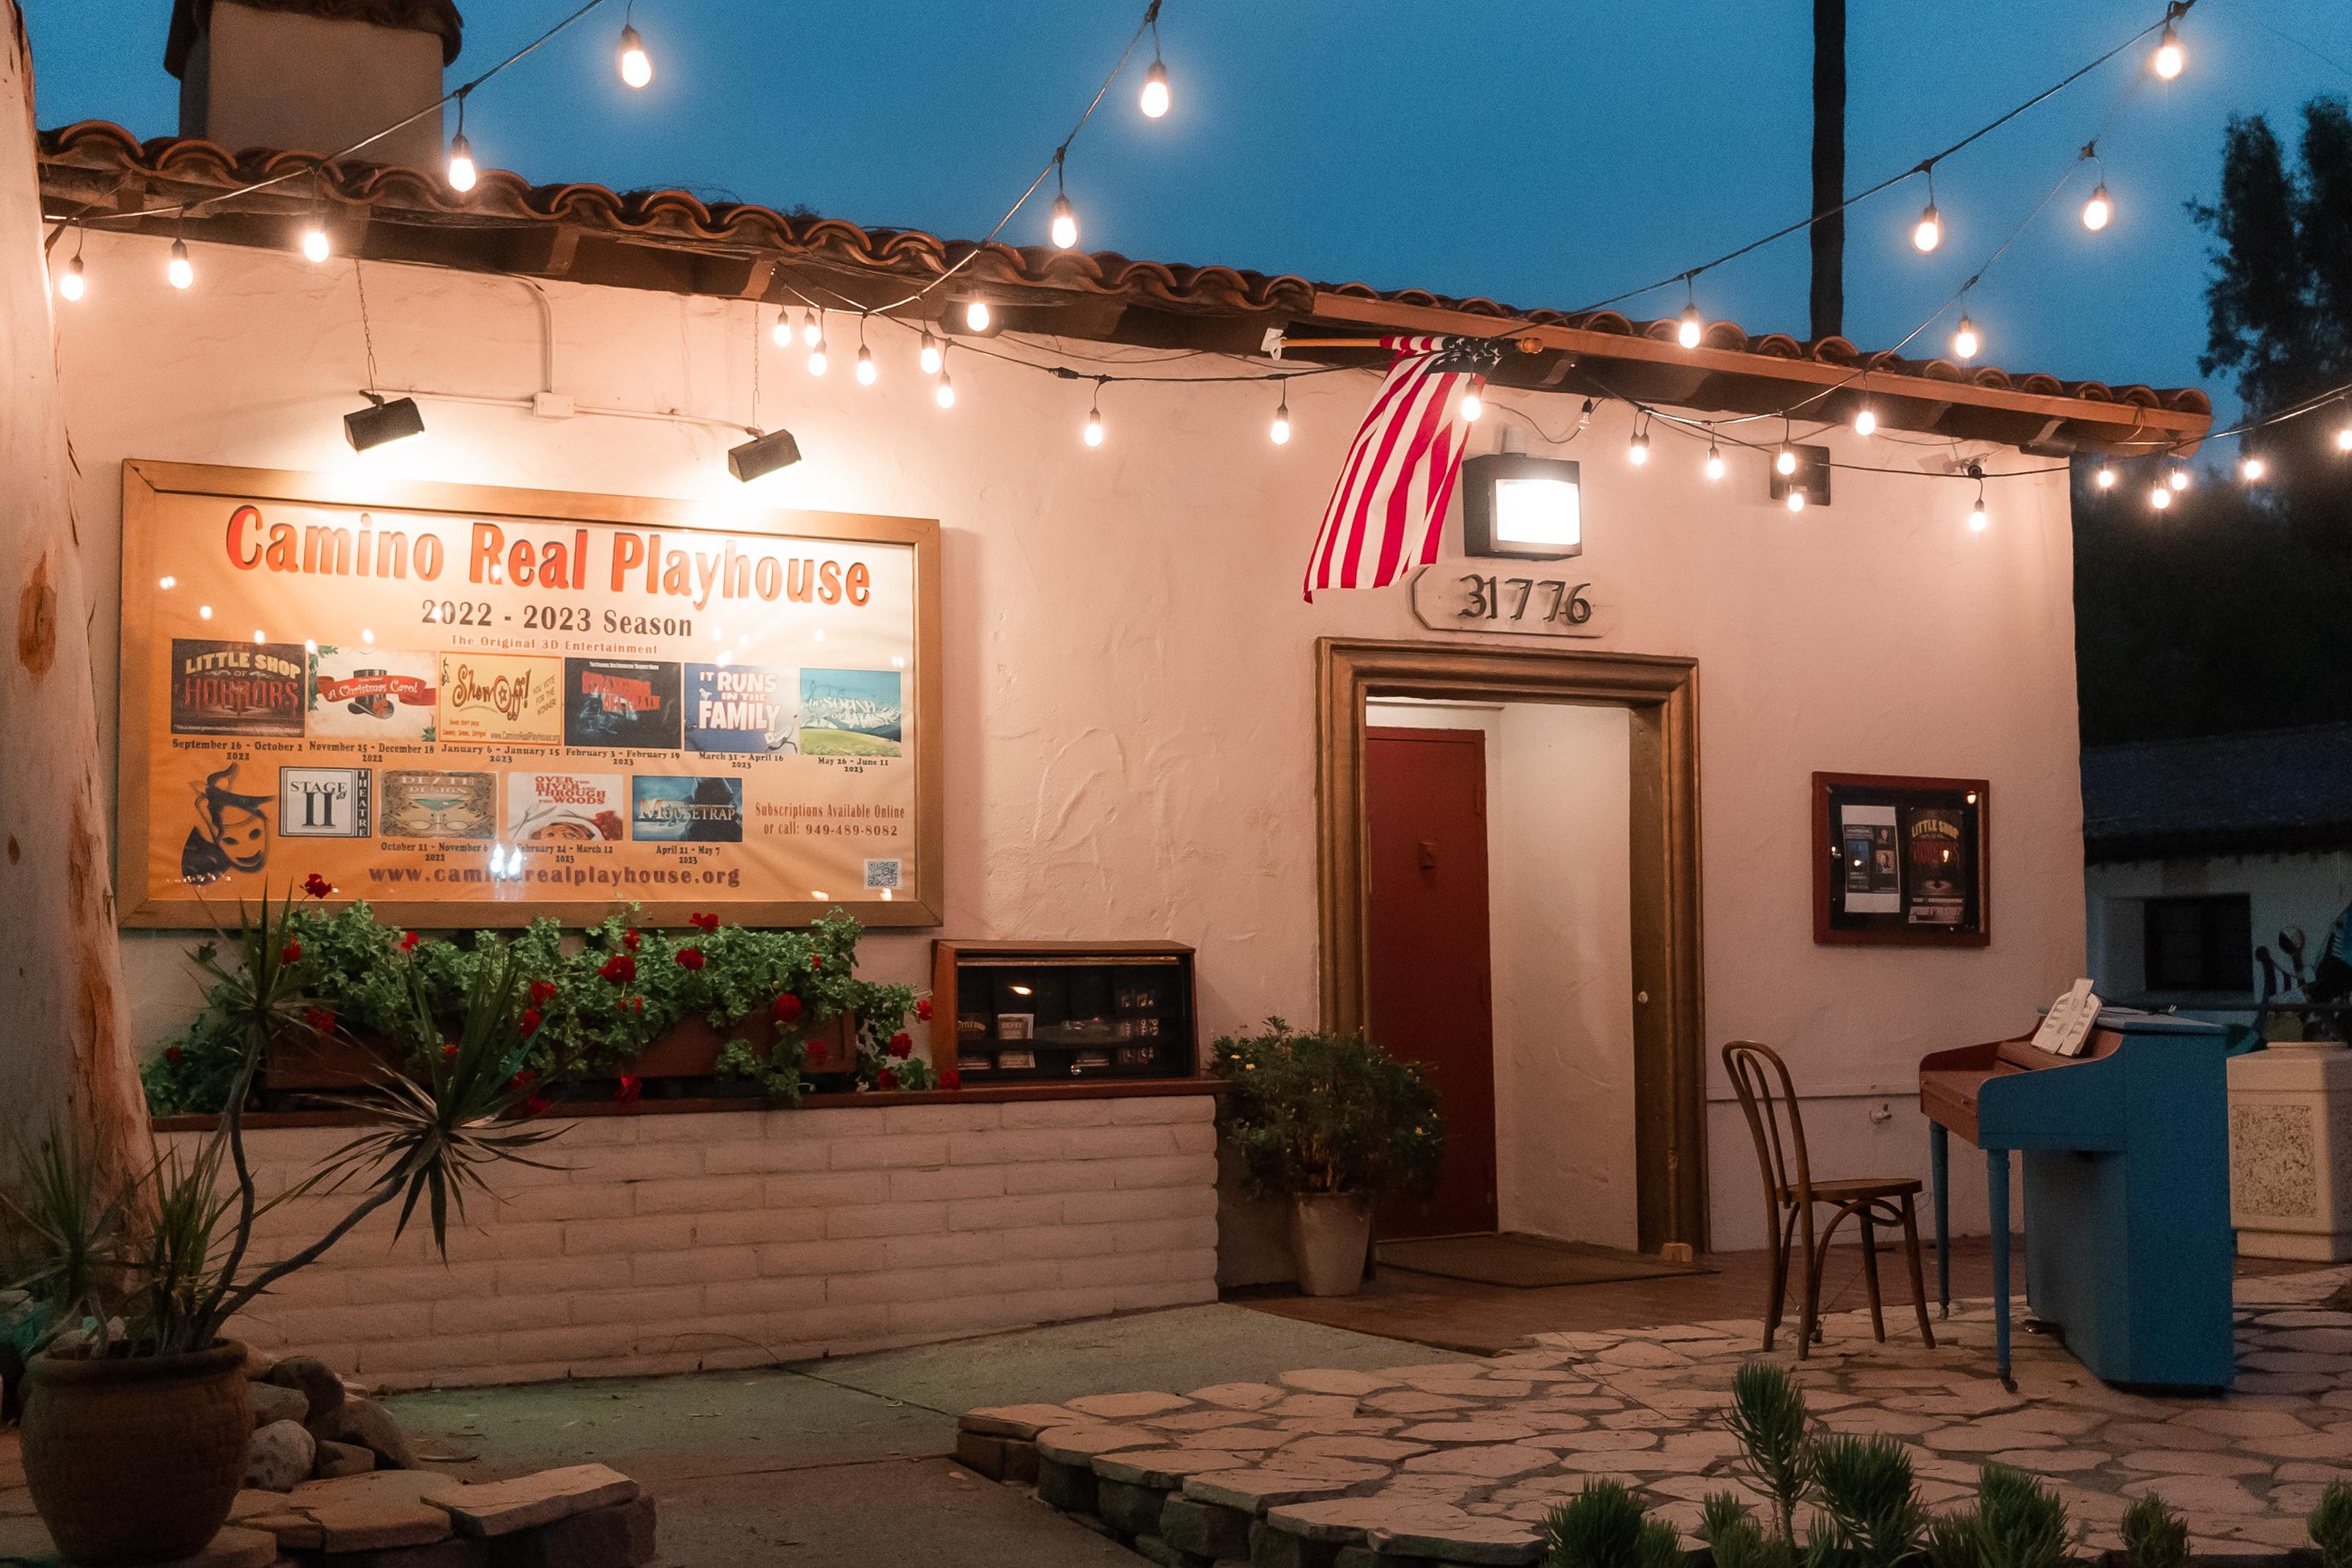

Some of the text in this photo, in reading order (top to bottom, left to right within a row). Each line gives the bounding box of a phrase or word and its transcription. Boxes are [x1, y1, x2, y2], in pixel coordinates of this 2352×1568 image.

[227, 504, 870, 611] Camino Real Playhouse
[1458, 574, 1591, 623] 31776
[422, 600, 492, 626] 2022
[523, 605, 591, 631] 2023
[604, 610, 692, 636] Season
[451, 635, 658, 655] The Original 3D Entertainment
[185, 651, 301, 679] LITTLE SHOP
[699, 671, 777, 693] IT RUNS
[185, 677, 299, 714] HORRORS
[328, 680, 418, 700] A Christmas Carol
[721, 692, 768, 702] IN THE
[699, 700, 782, 732] FAMILY
[172, 739, 227, 750] September
[231, 742, 242, 750] 16
[254, 741, 294, 751] October
[298, 743, 303, 751] 2
[309, 741, 354, 751] November
[358, 744, 367, 753] 25
[378, 743, 421, 754] December
[425, 746, 434, 754] 18
[441, 744, 483, 754] January
[504, 746, 545, 757] January
[227, 752, 250, 760] 2022
[362, 754, 383, 762] 2022
[566, 748, 608, 758] February
[627, 751, 667, 759] February
[699, 752, 726, 760] March
[749, 754, 771, 762] April
[818, 757, 835, 765] May
[535, 776, 574, 784] OVER
[290, 781, 348, 792] STAGE
[536, 782, 580, 792] RIVER
[537, 789, 606, 798] THROUGH
[358, 770, 367, 836] THEATRE
[553, 796, 605, 804] WOODS
[301, 791, 336, 827] II
[755, 803, 905, 819] Subscriptions Available Online
[764, 821, 897, 836] or call: 949-489-8082
[381, 842, 415, 851] October
[438, 843, 480, 851] November
[517, 844, 554, 854] February
[557, 845, 566, 853] 24
[576, 844, 601, 853] March
[656, 845, 677, 854] April
[698, 847, 713, 855] May
[425, 854, 445, 862] 2022
[679, 856, 697, 864] 2023
